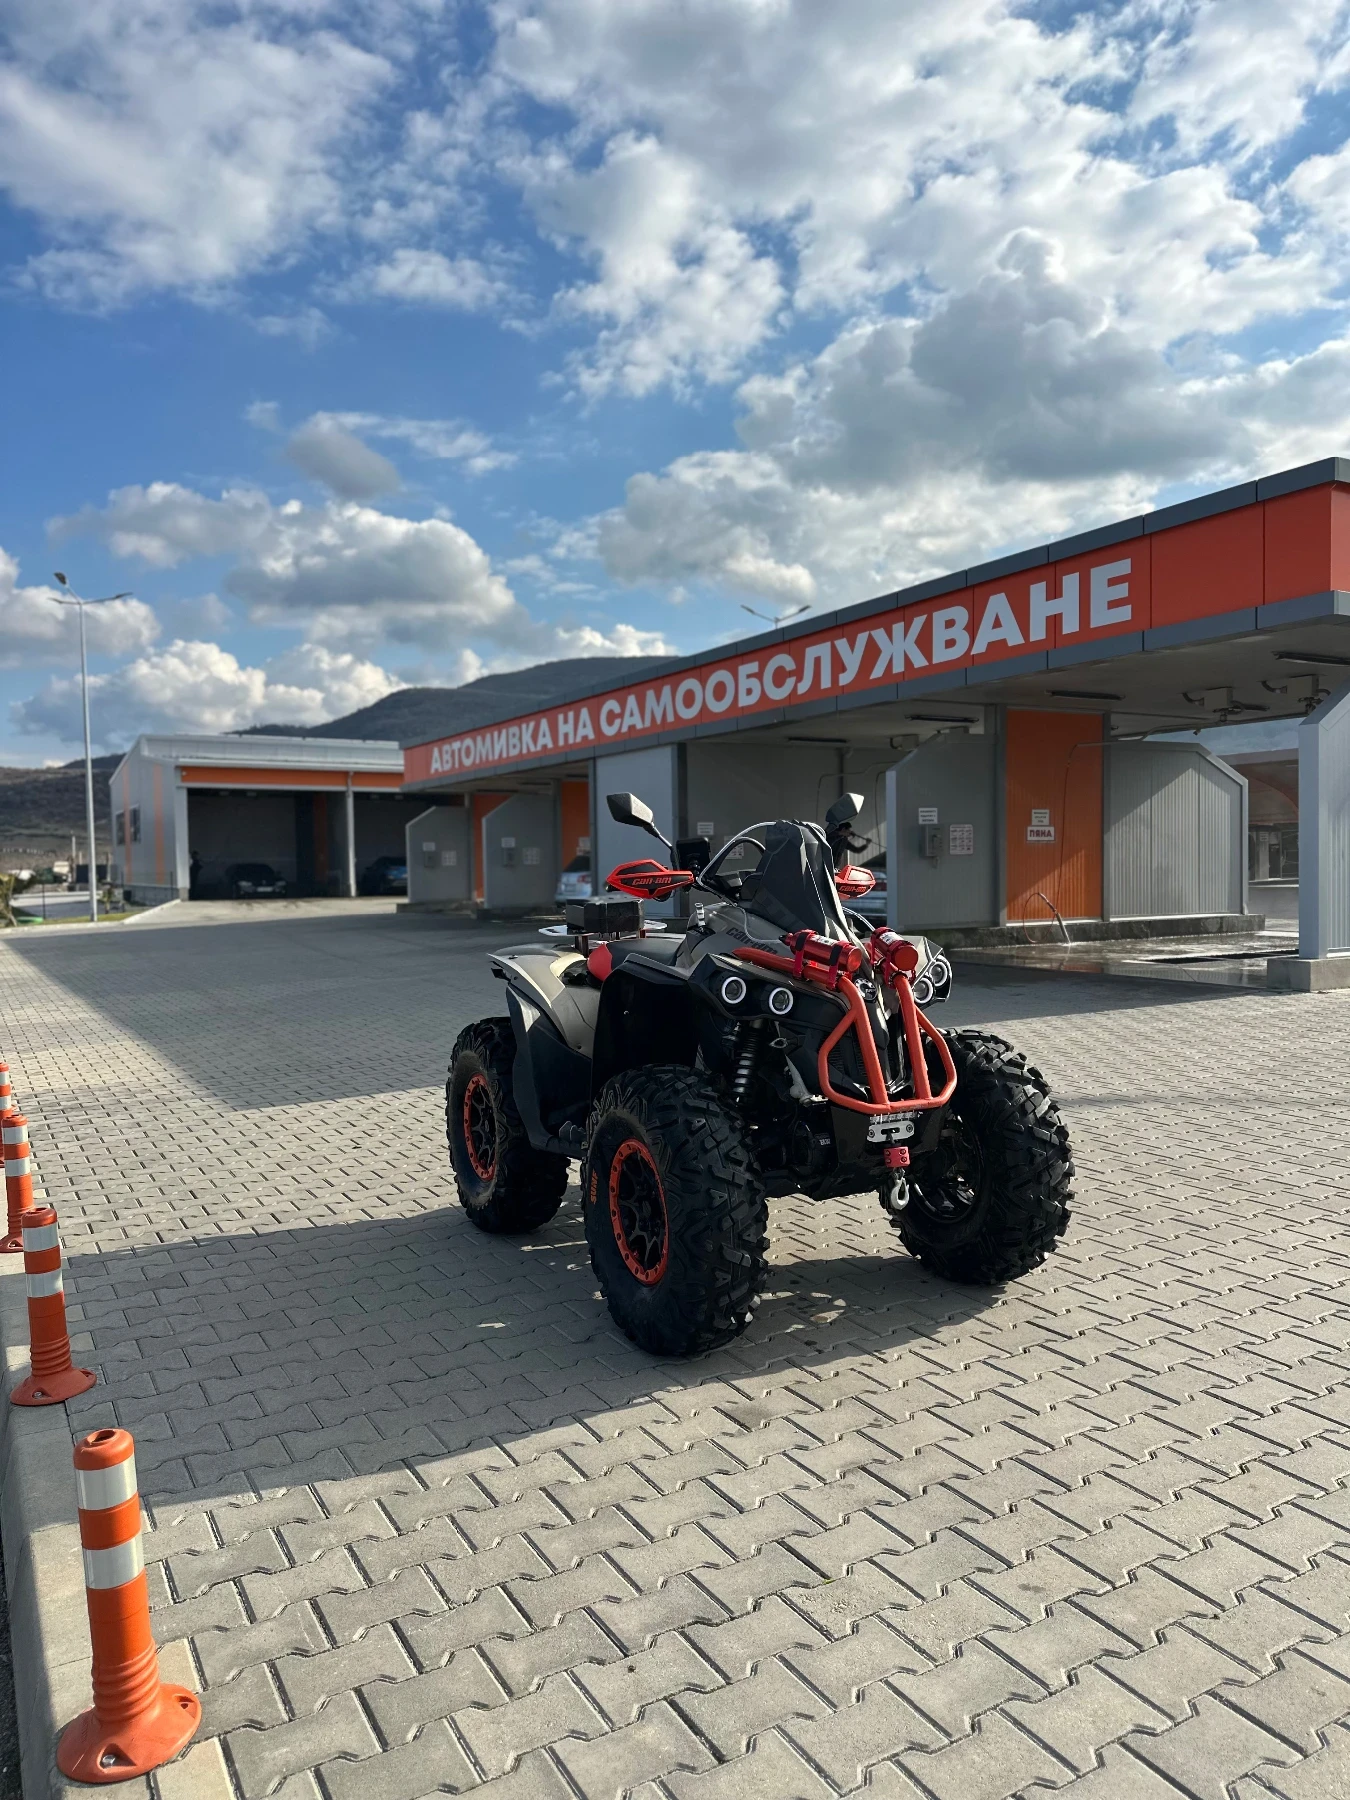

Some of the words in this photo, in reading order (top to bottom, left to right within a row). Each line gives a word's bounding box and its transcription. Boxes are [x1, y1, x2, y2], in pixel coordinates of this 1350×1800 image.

[430, 718, 553, 775] АВТОМИВКА
[557, 707, 595, 746] НА
[599, 557, 1132, 737] САМООБСЛУЖВАНЕ
[1029, 829, 1053, 838] ПЯНА
